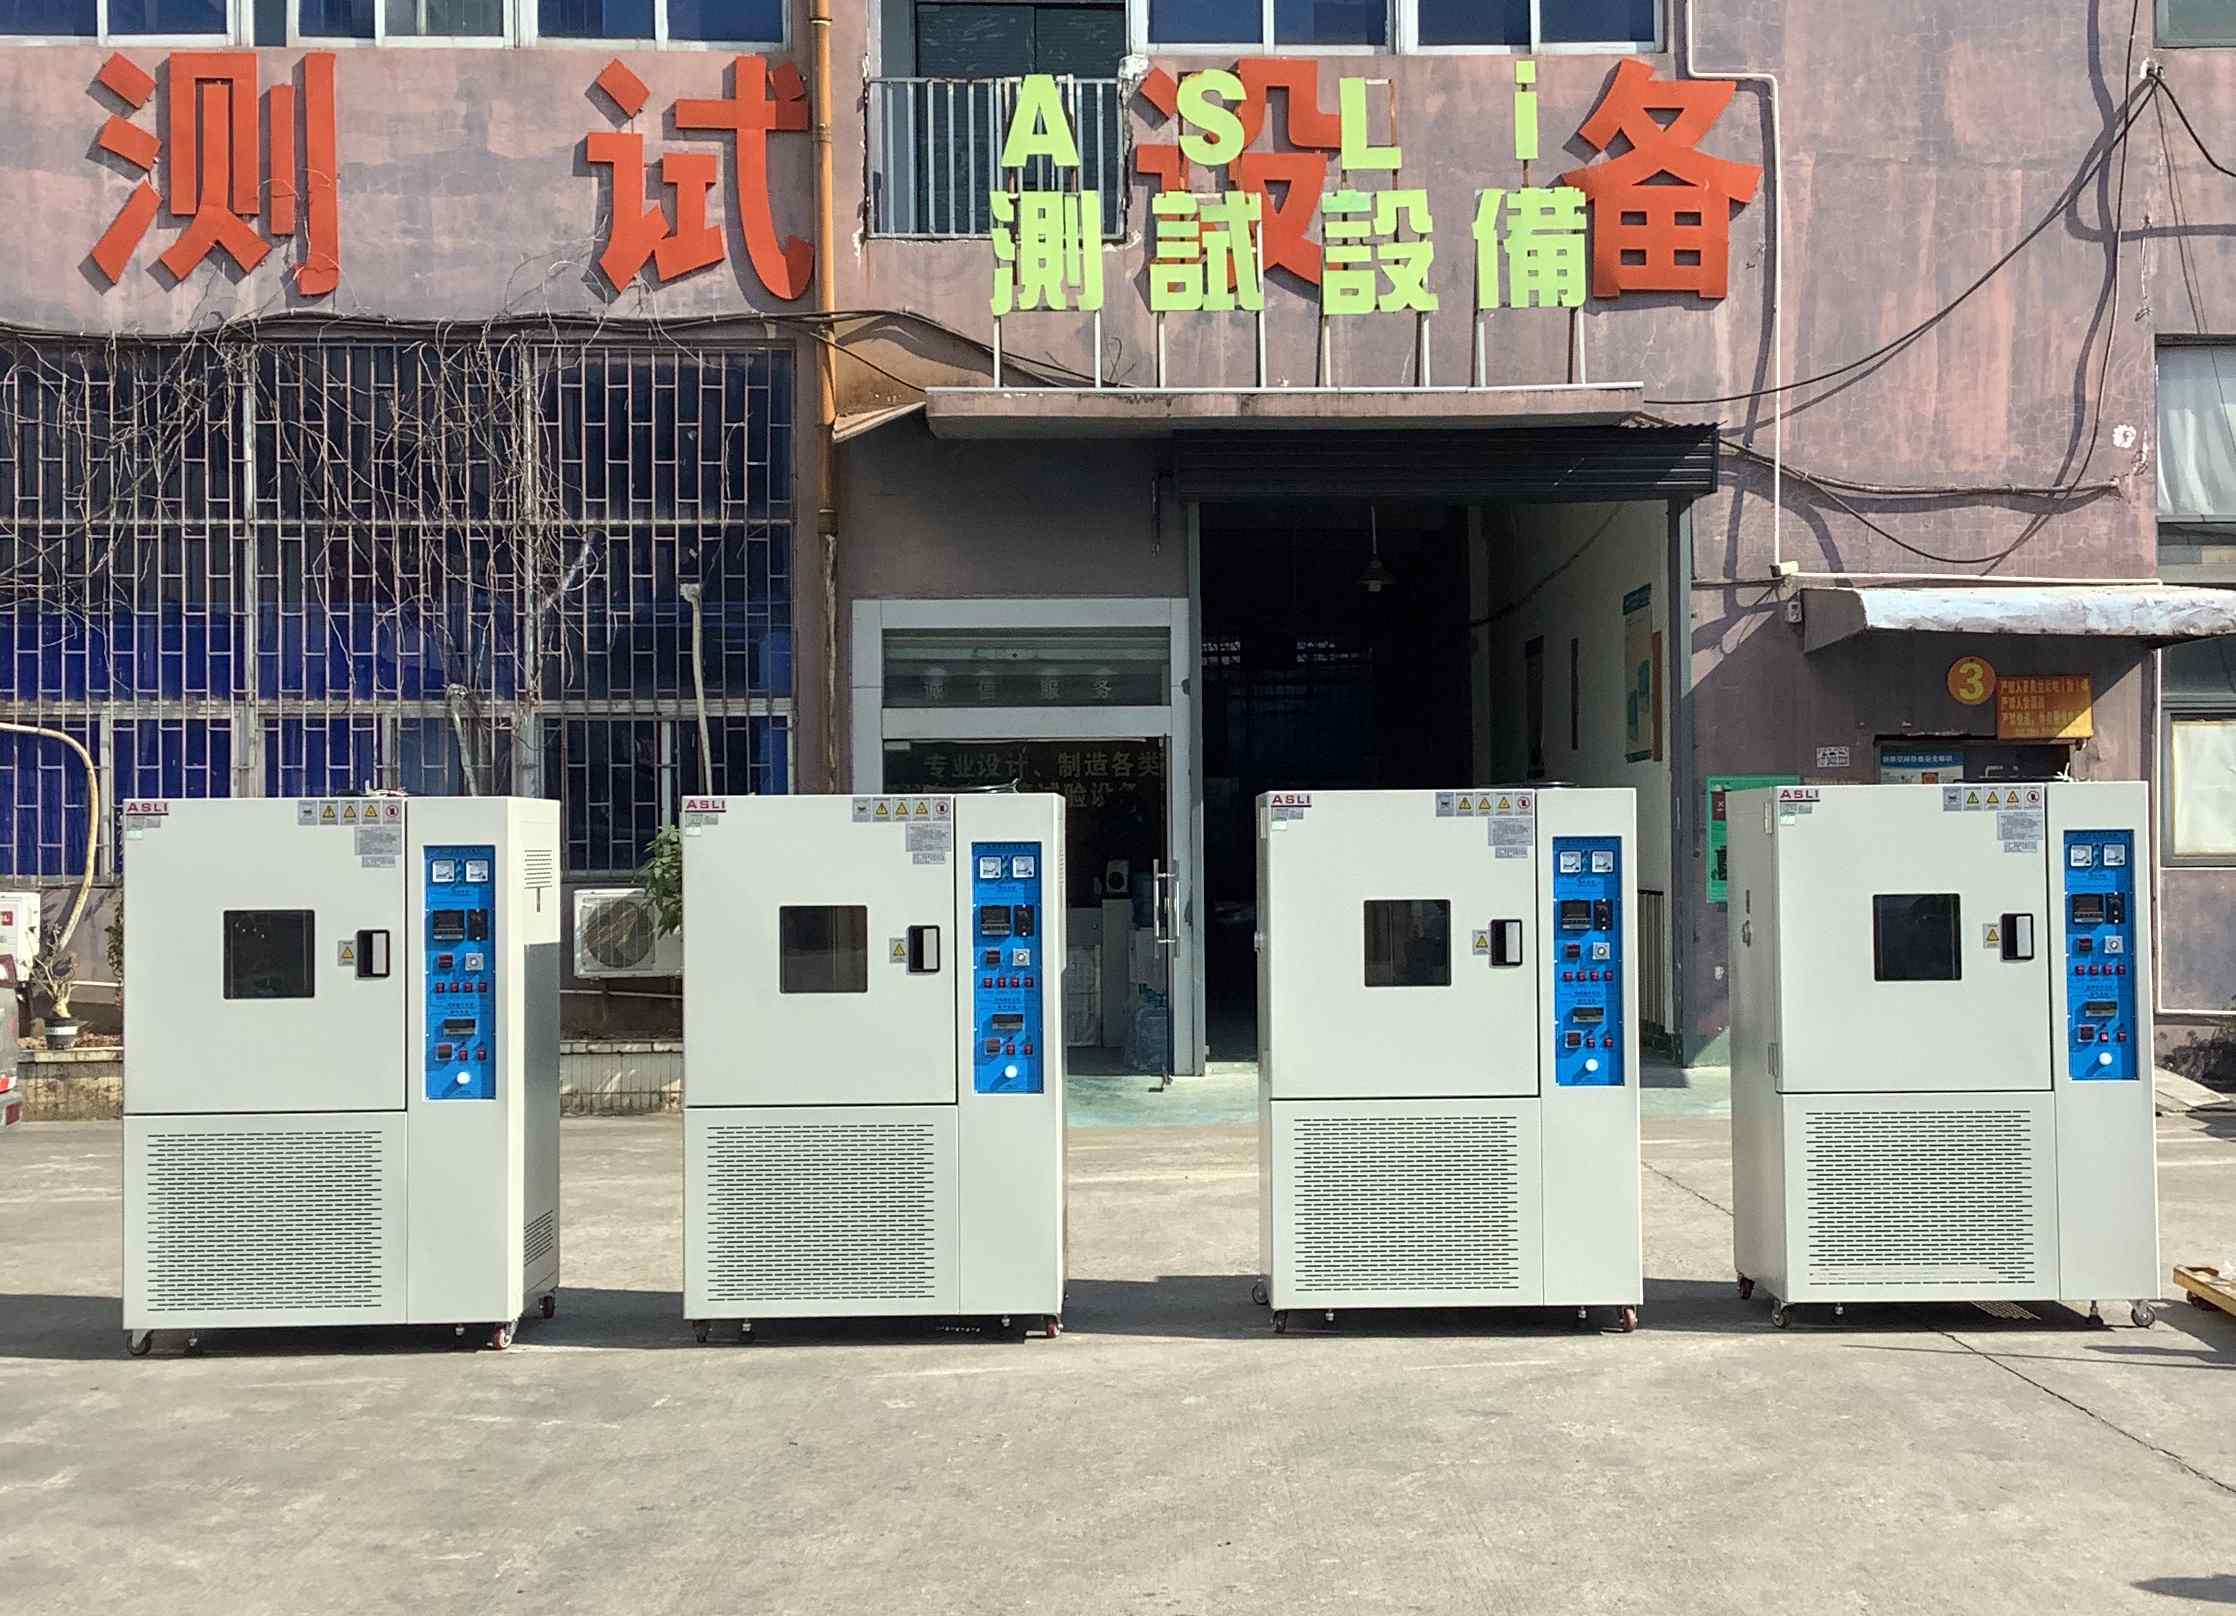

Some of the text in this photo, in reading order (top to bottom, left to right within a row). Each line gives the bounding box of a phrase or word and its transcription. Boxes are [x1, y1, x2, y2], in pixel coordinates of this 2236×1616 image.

[990, 187, 1587, 317] 測試設備
[1959, 662, 1984, 700] 3
[1271, 794, 1311, 804] ASLI
[1780, 789, 1819, 799] ASLI
[127, 802, 168, 812] ASLI
[686, 799, 726, 809] ASLI
